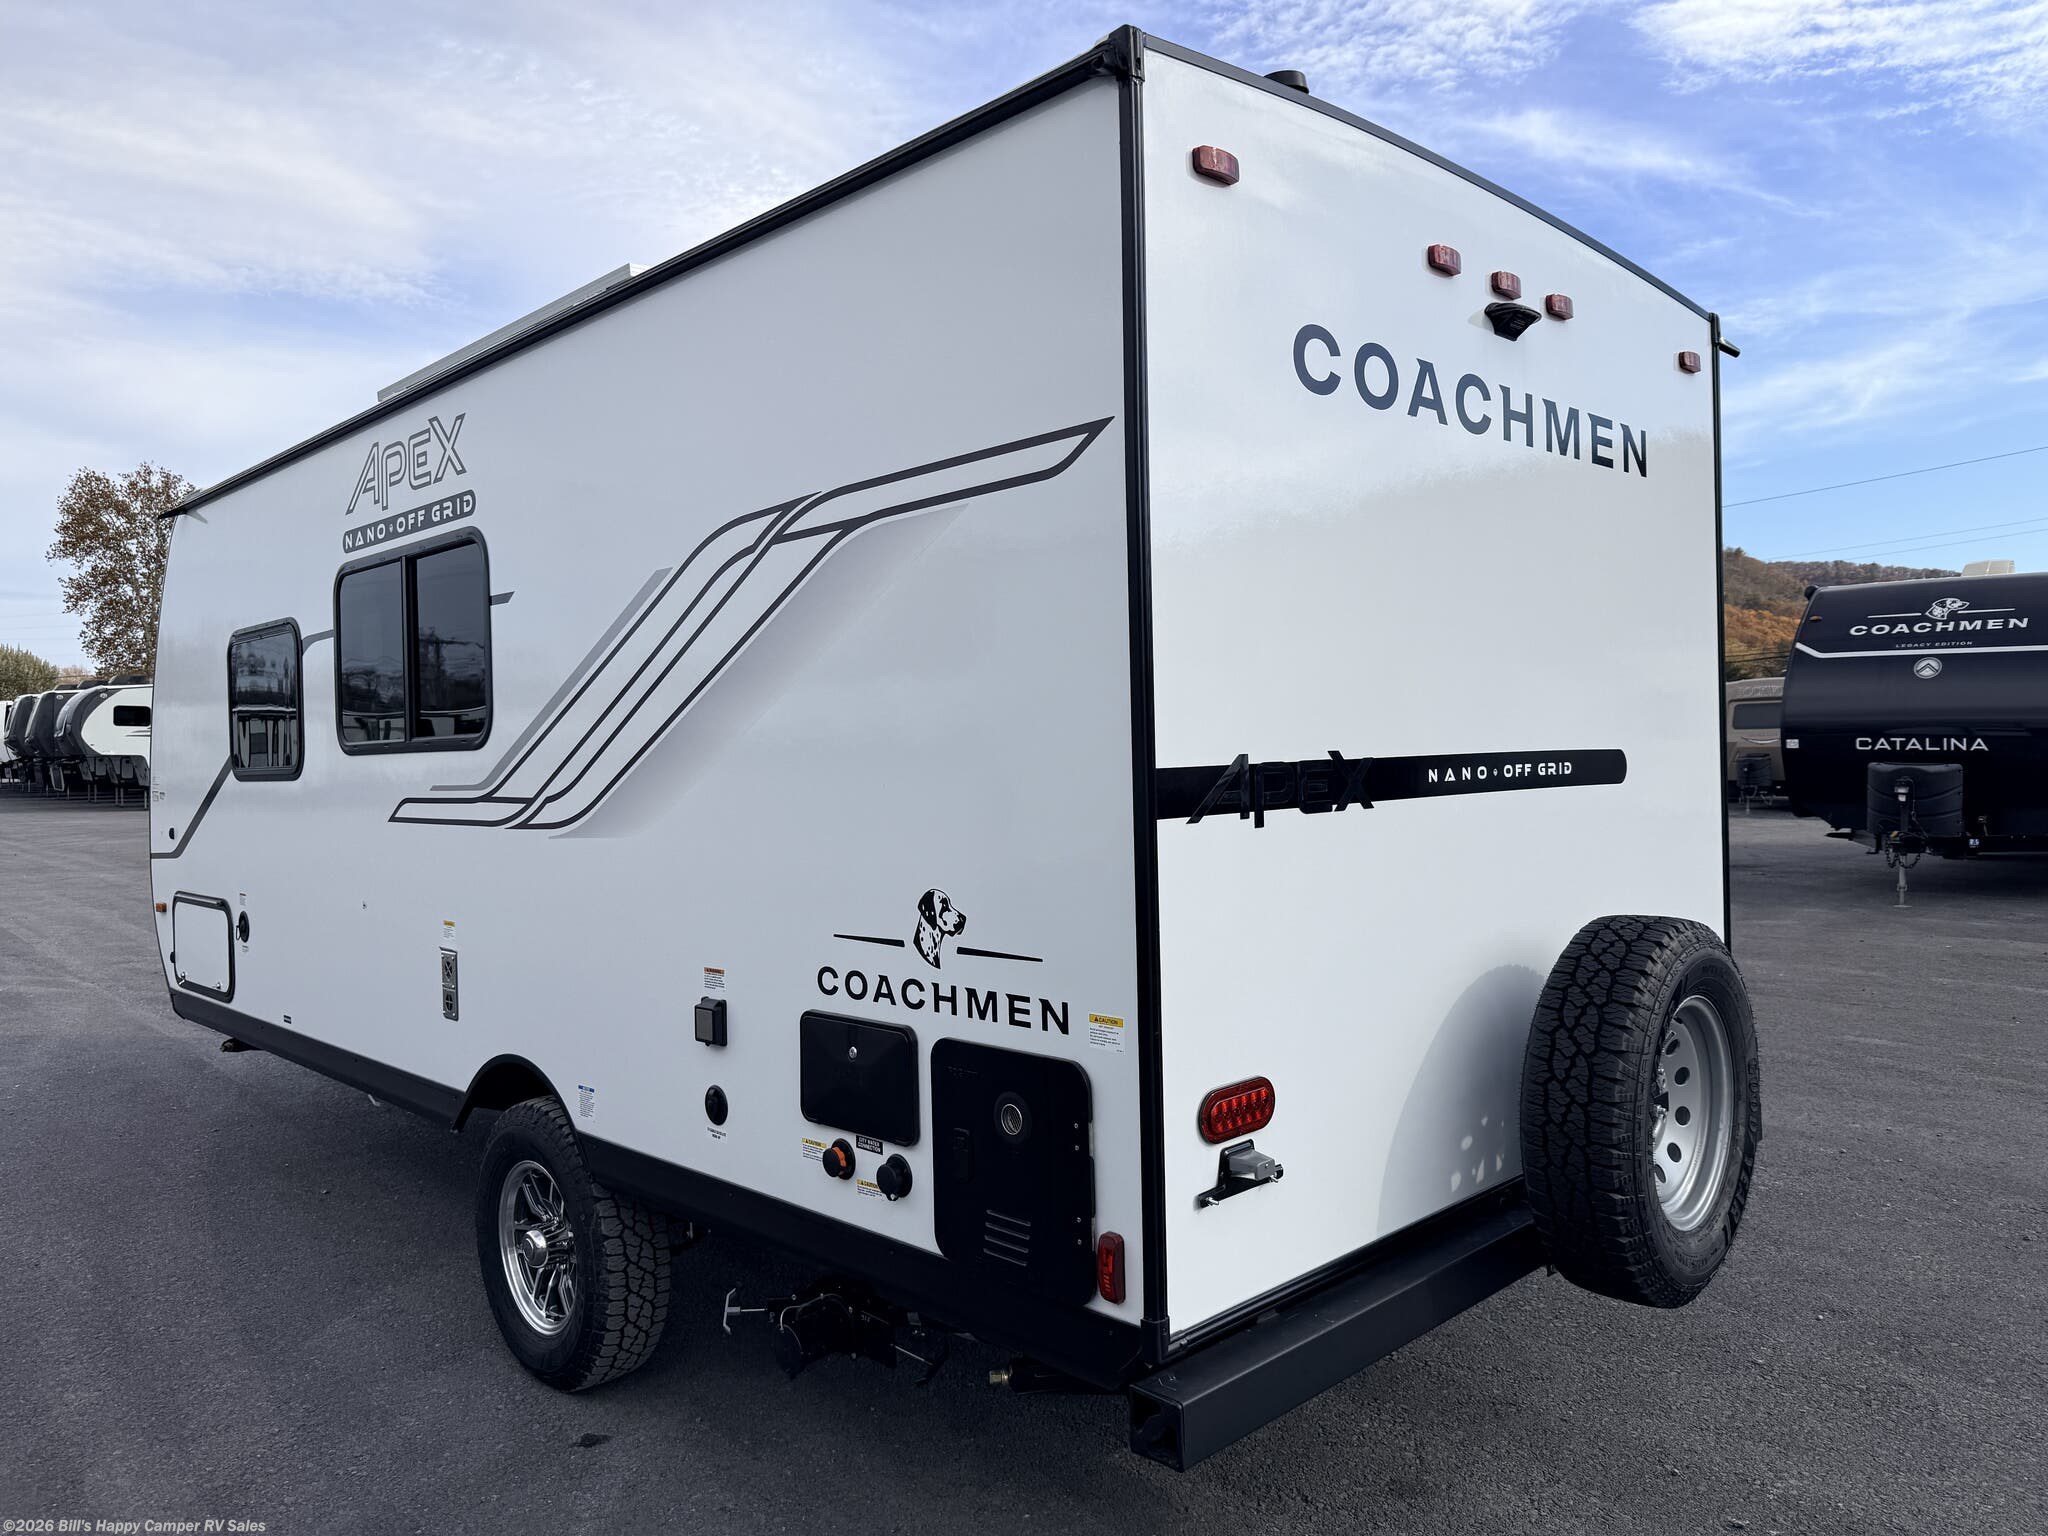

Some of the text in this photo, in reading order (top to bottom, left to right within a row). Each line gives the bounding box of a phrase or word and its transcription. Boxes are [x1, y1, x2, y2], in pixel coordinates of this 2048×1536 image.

[1293, 323, 1648, 478] COACHMEN
[345, 412, 467, 515] APEX
[345, 494, 473, 550] NANO OFF GRID
[1849, 617, 2029, 636] COACHMEN
[1428, 761, 1573, 783] NANO OFF GRID
[1855, 737, 1989, 751] CATALINA
[1186, 750, 1375, 829] APEX
[816, 965, 1070, 1036] COACHMEN
